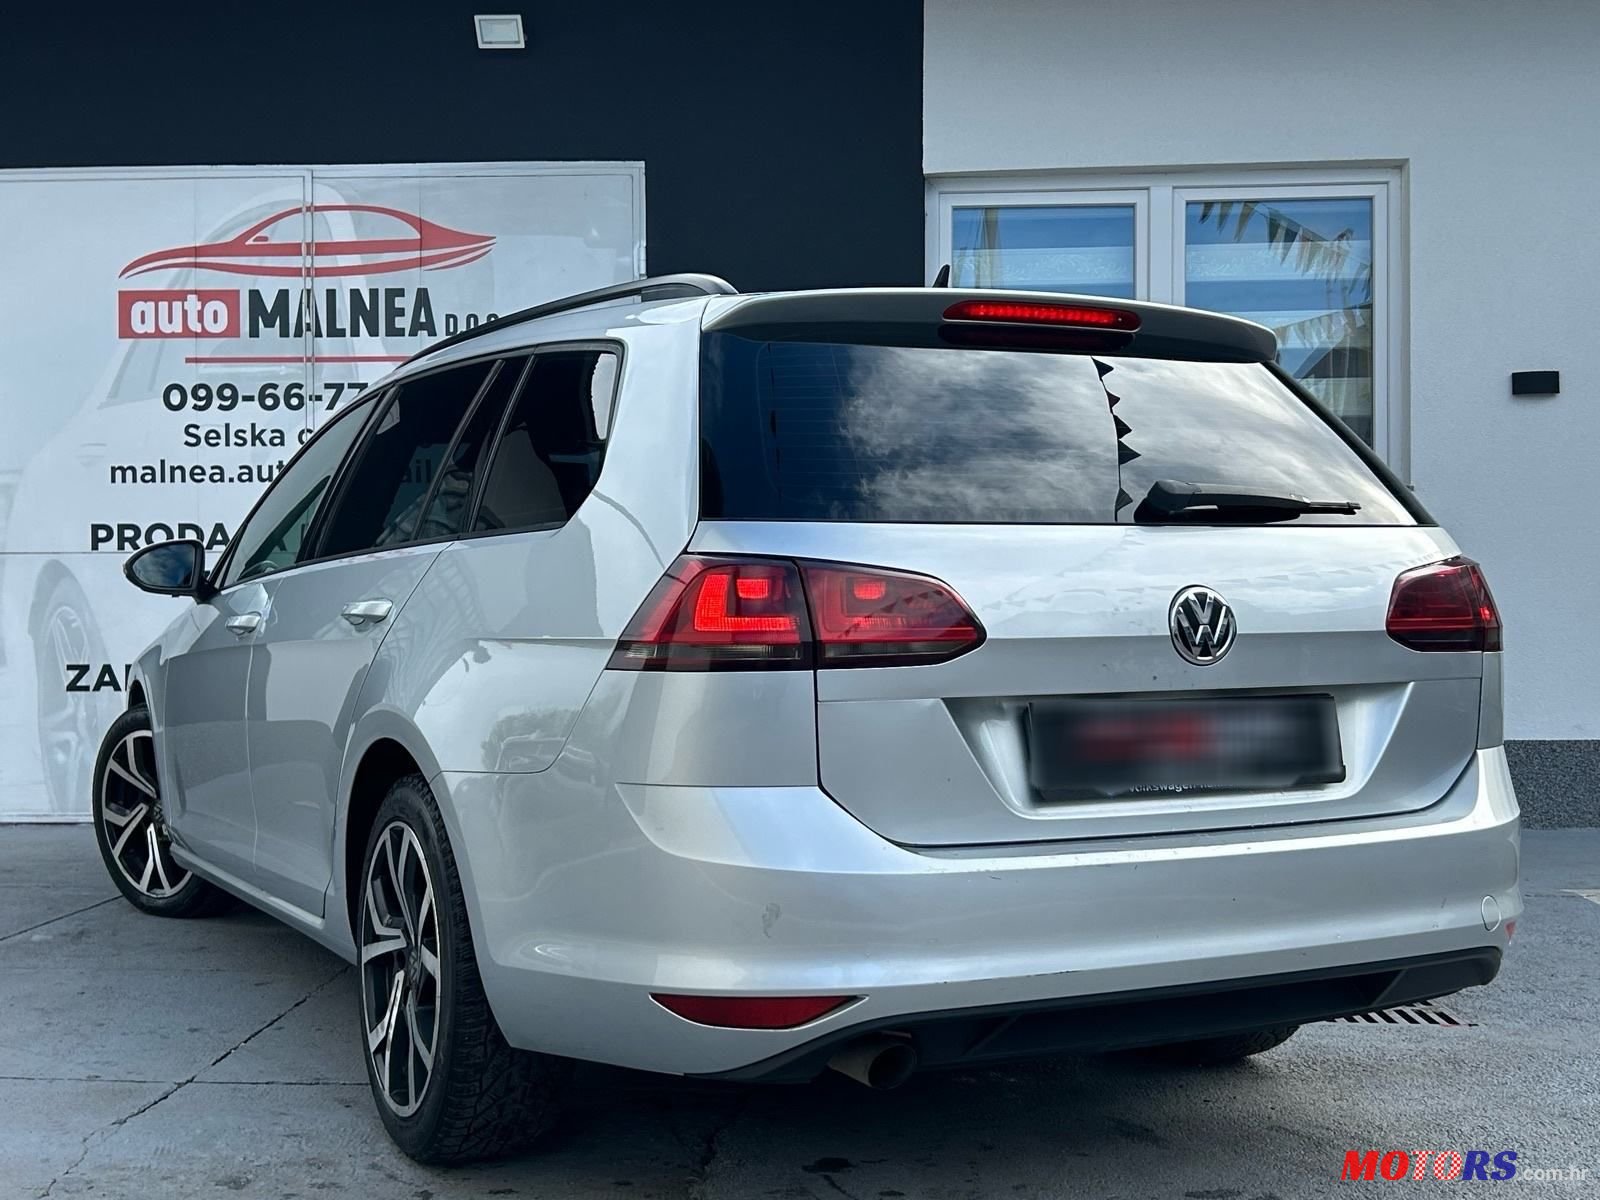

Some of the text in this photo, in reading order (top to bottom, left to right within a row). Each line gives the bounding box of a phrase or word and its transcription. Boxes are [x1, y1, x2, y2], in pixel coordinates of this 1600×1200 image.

[130, 294, 229, 334] auto
[248, 287, 437, 338] MALNEA
[183, 422, 286, 448] Selska
